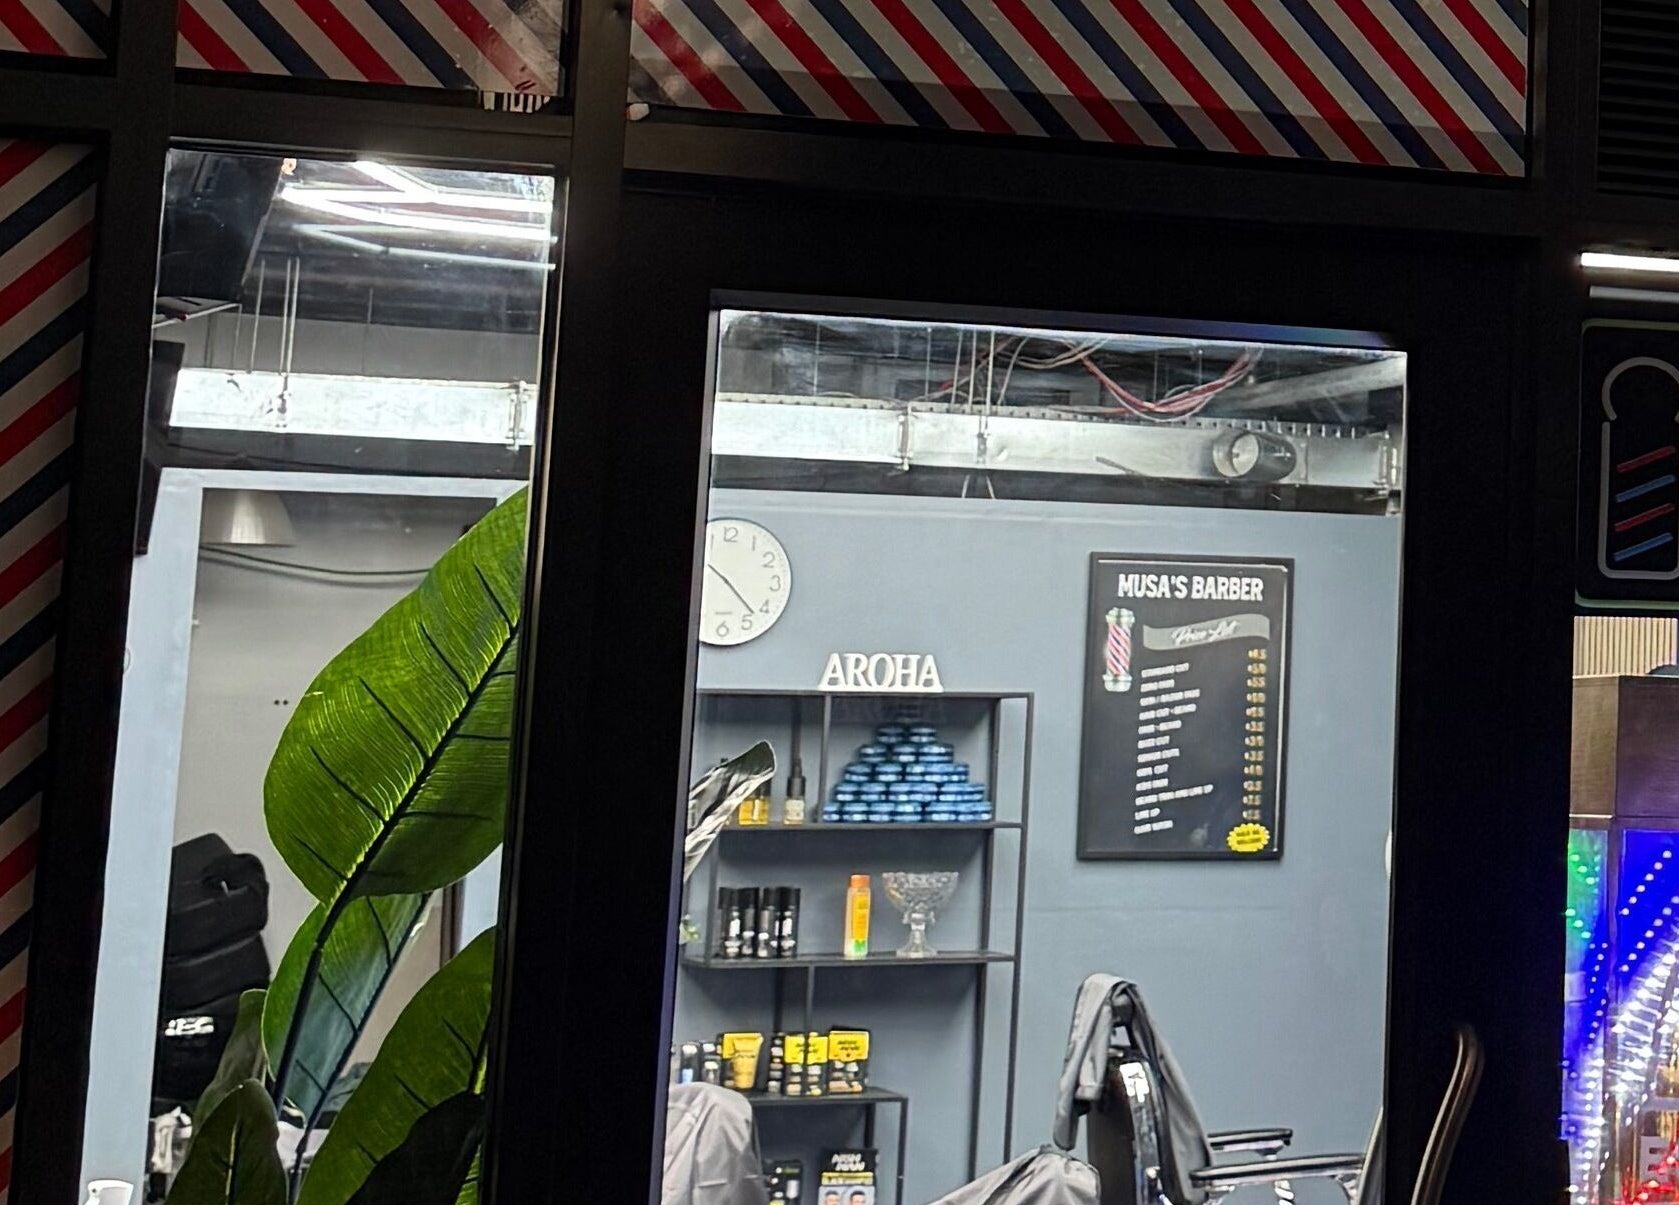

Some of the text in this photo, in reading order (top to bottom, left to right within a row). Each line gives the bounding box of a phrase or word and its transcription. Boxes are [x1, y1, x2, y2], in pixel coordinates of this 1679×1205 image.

[723, 526, 739, 543] 12
[762, 551, 776, 568] 2
[769, 574, 782, 592] 3
[1117, 573, 1265, 602] MUSA'S BARBER
[759, 599, 771, 614] 4
[716, 621, 730, 638] 6
[741, 613, 753, 631] 5
[817, 652, 945, 693] AROHA
